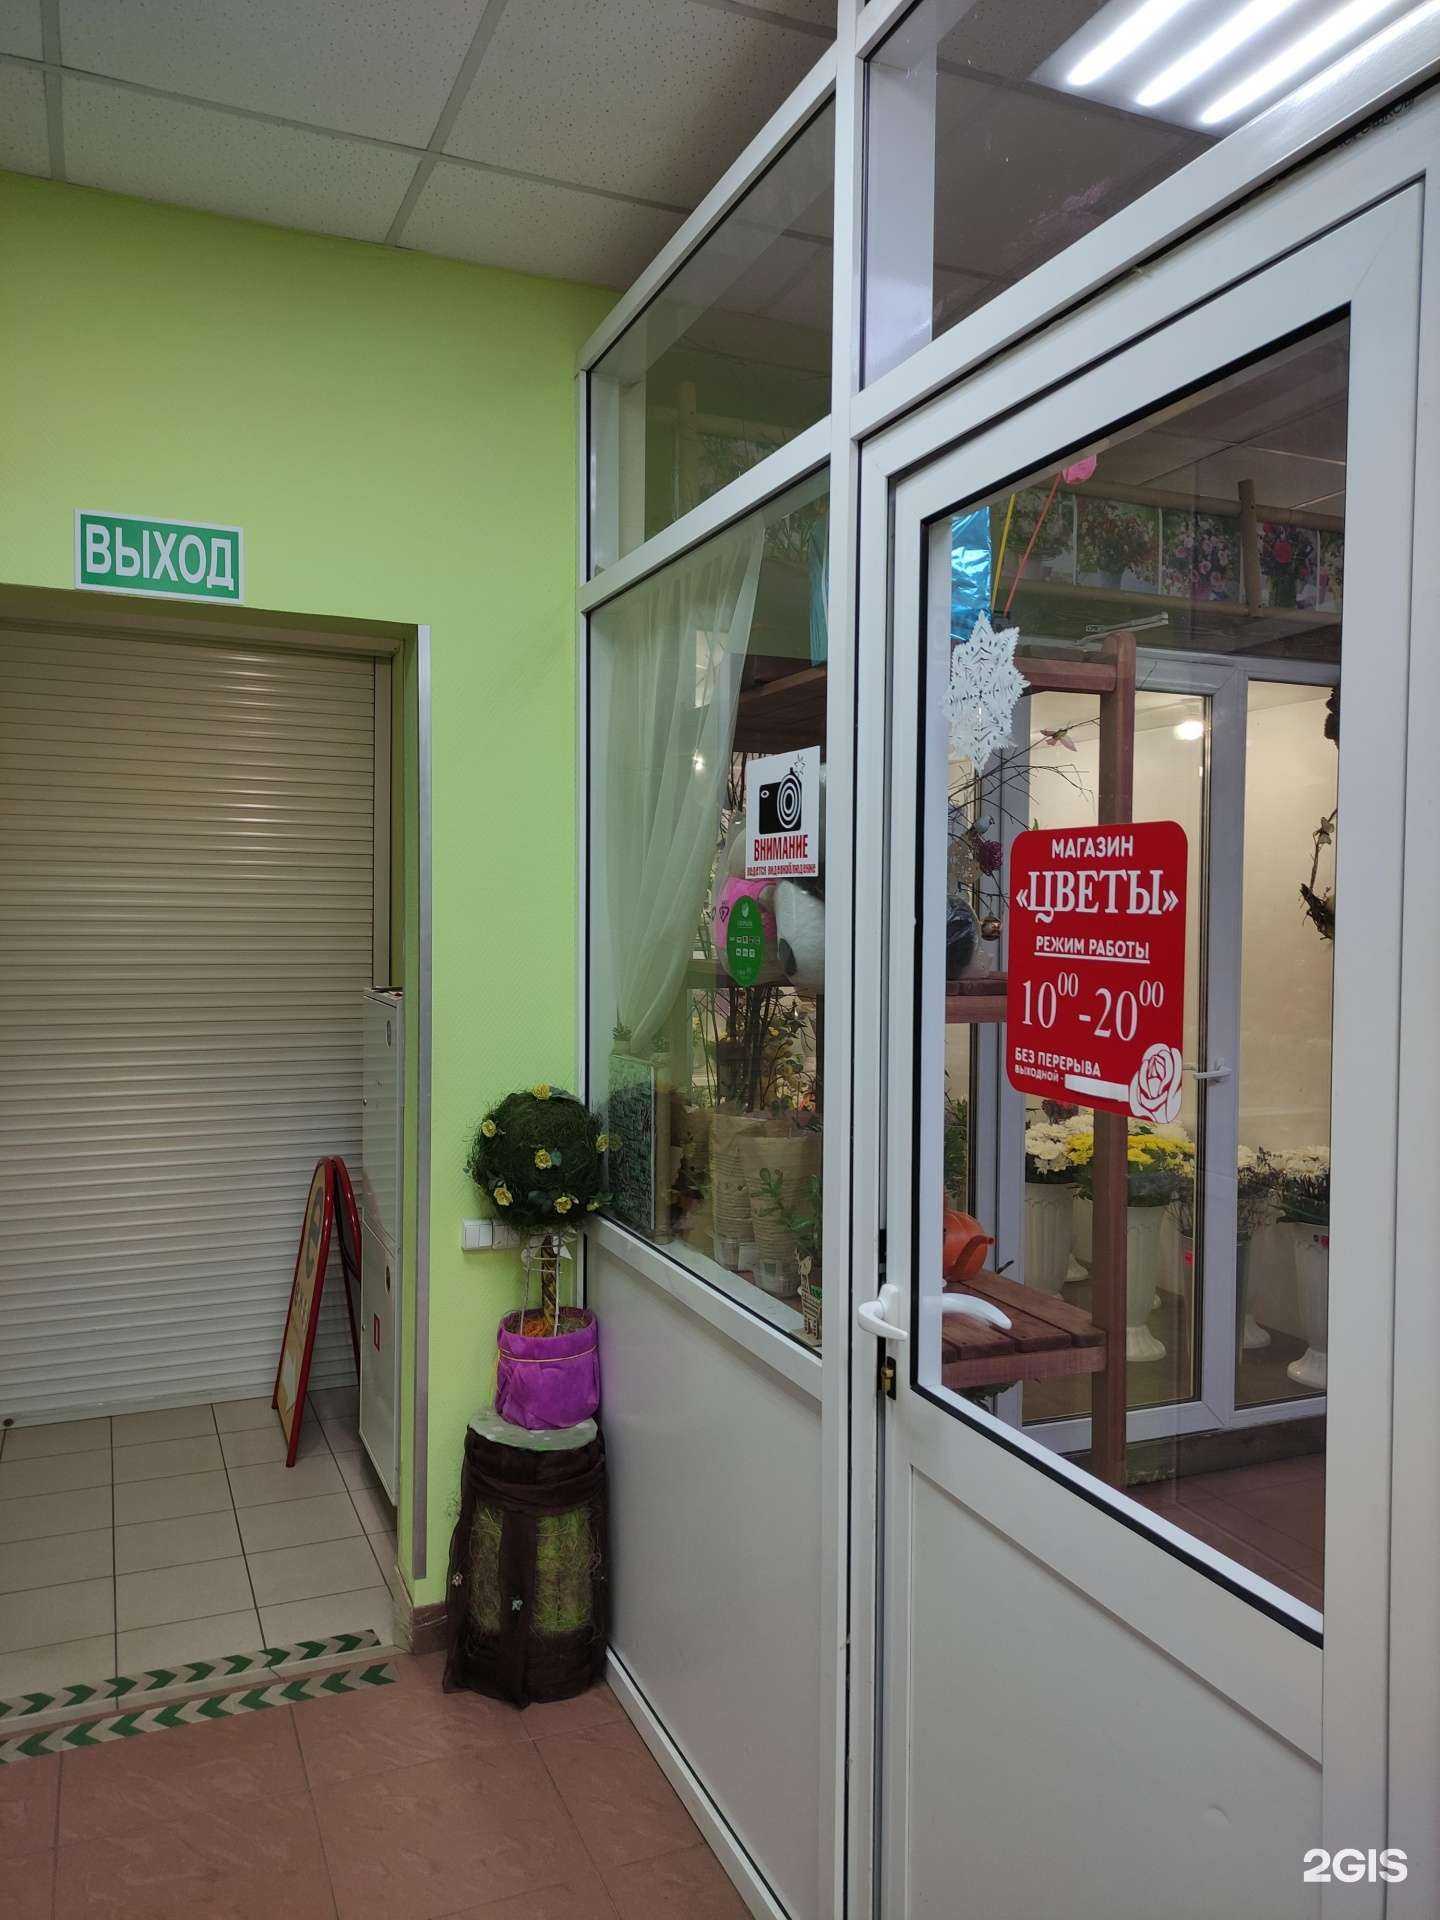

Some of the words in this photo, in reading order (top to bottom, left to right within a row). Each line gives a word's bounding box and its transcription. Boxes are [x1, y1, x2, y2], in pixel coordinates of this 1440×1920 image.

[85, 523, 234, 591] ВЫХОД
[754, 834, 808, 861] ВНИМАНИЕ
[1051, 835, 1134, 859] МАГАЗИН
[1015, 869, 1179, 924] «ЦВЕТЫ»
[1035, 935, 1085, 955] РЕЖИМ
[1088, 939, 1149, 960] РАБОТЫ
[1014, 1064, 1059, 1083] ВЫХОДНОЙ
[1015, 1047, 1035, 1064] БЕЗ
[1038, 1051, 1101, 1077] ПЕРЕРЫВА
